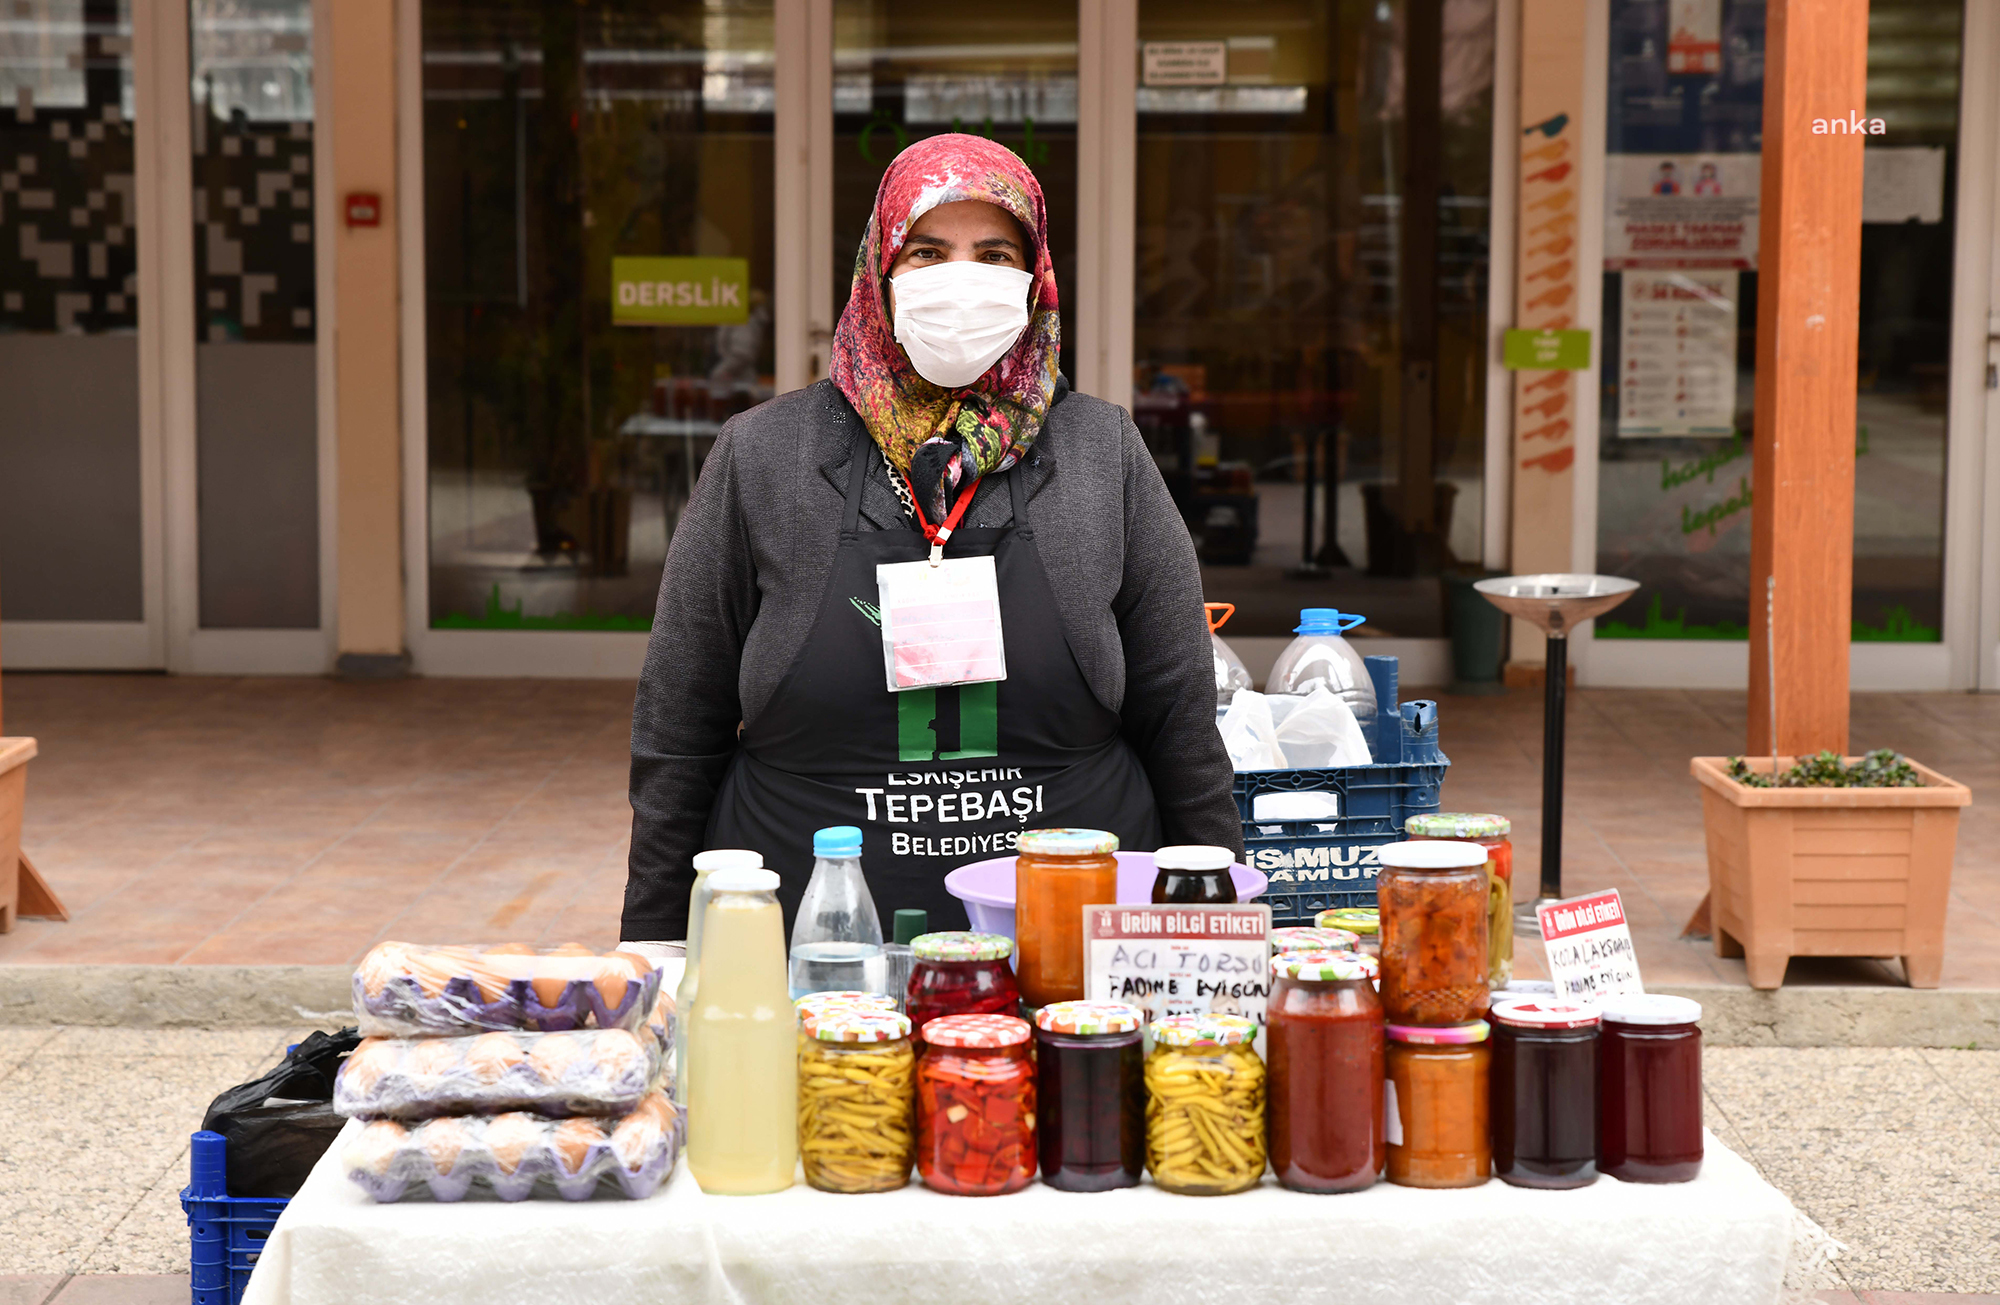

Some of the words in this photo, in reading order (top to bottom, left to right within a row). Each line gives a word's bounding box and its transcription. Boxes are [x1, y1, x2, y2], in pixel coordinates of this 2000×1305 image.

[619, 276, 740, 307] DERSLİK
[855, 785, 1043, 823] TEPEBAŞI
[892, 827, 1026, 856] BELEDİYES
[1294, 845, 1379, 868] MUZ
[1268, 867, 1385, 883] AMUR
[1121, 912, 1162, 934] ÜRÜN
[1166, 912, 1206, 935] BİLGİ
[1210, 912, 1264, 935] ETİKETİ
[1553, 908, 1577, 932] ÜRÜN
[1574, 903, 1597, 928] BİLGİ
[1594, 898, 1621, 923] ETİKETİ
[1112, 944, 1157, 969] ACI
